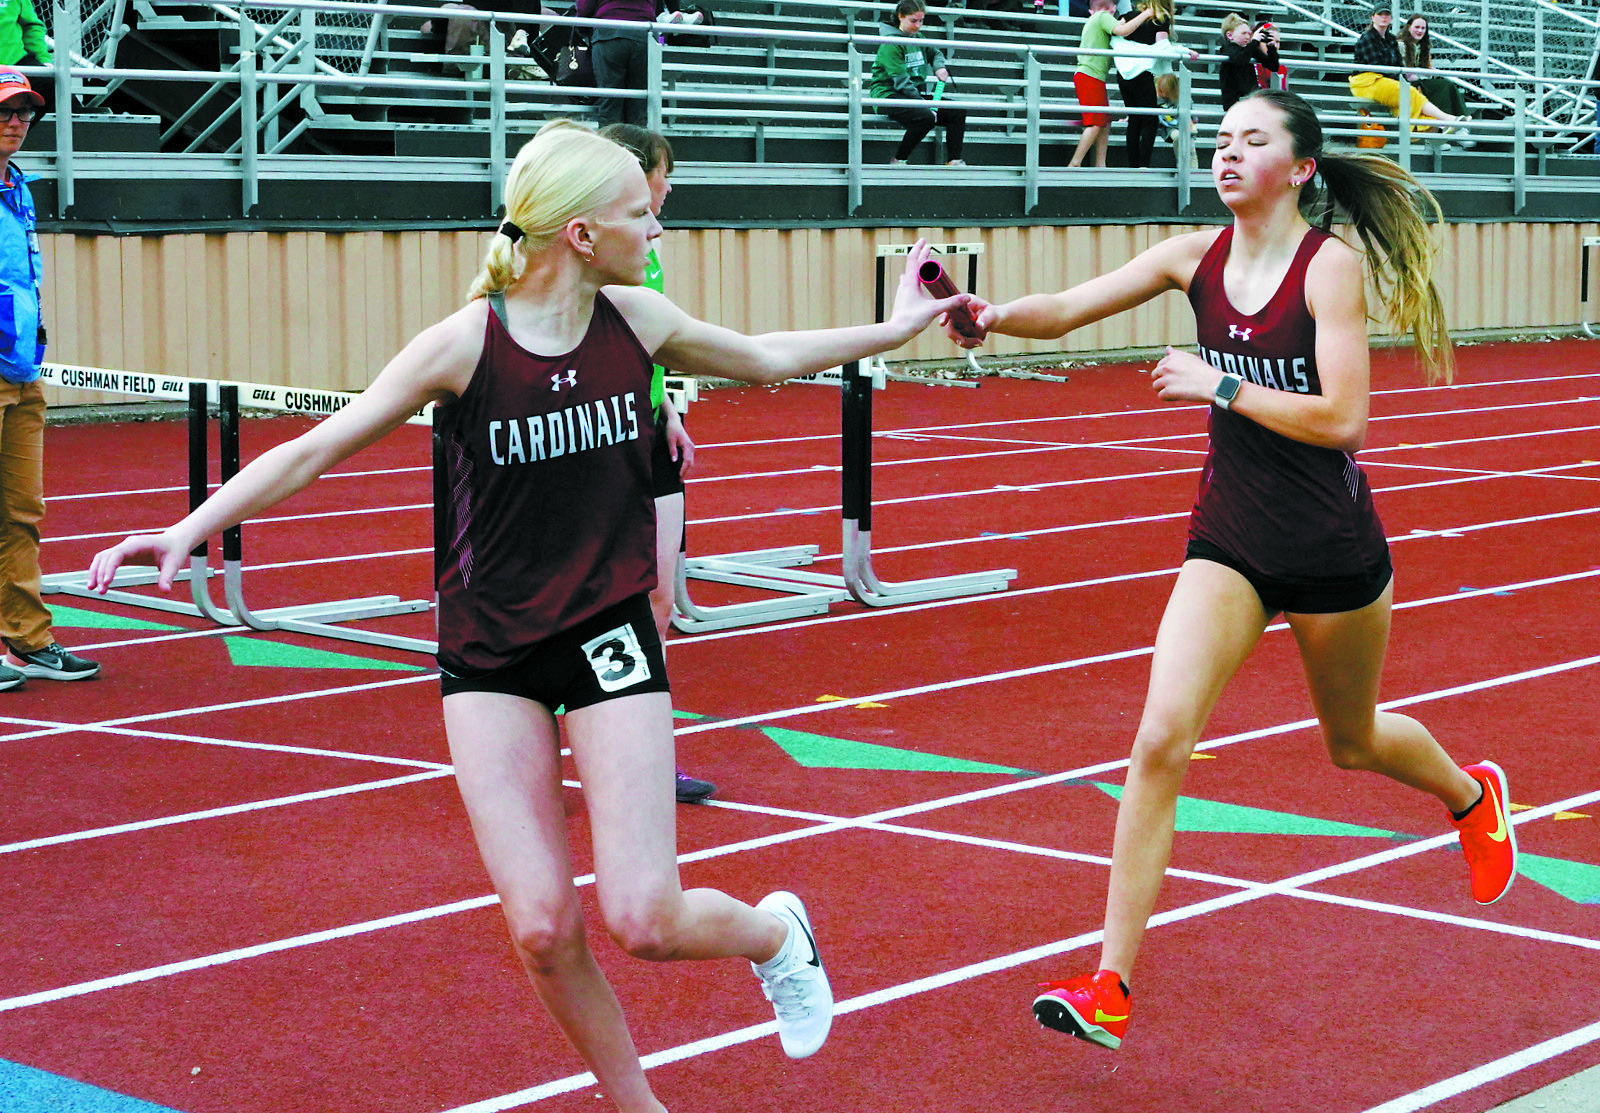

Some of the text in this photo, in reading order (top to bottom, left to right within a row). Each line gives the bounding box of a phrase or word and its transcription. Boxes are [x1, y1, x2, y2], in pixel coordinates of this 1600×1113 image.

[39, 367, 184, 394] ILL CUSHMAN FIELD GILL
[1201, 345, 1309, 393] RDINALS
[252, 389, 276, 401] GILL
[489, 392, 639, 466] CARDINALS
[591, 637, 636, 682] 3
